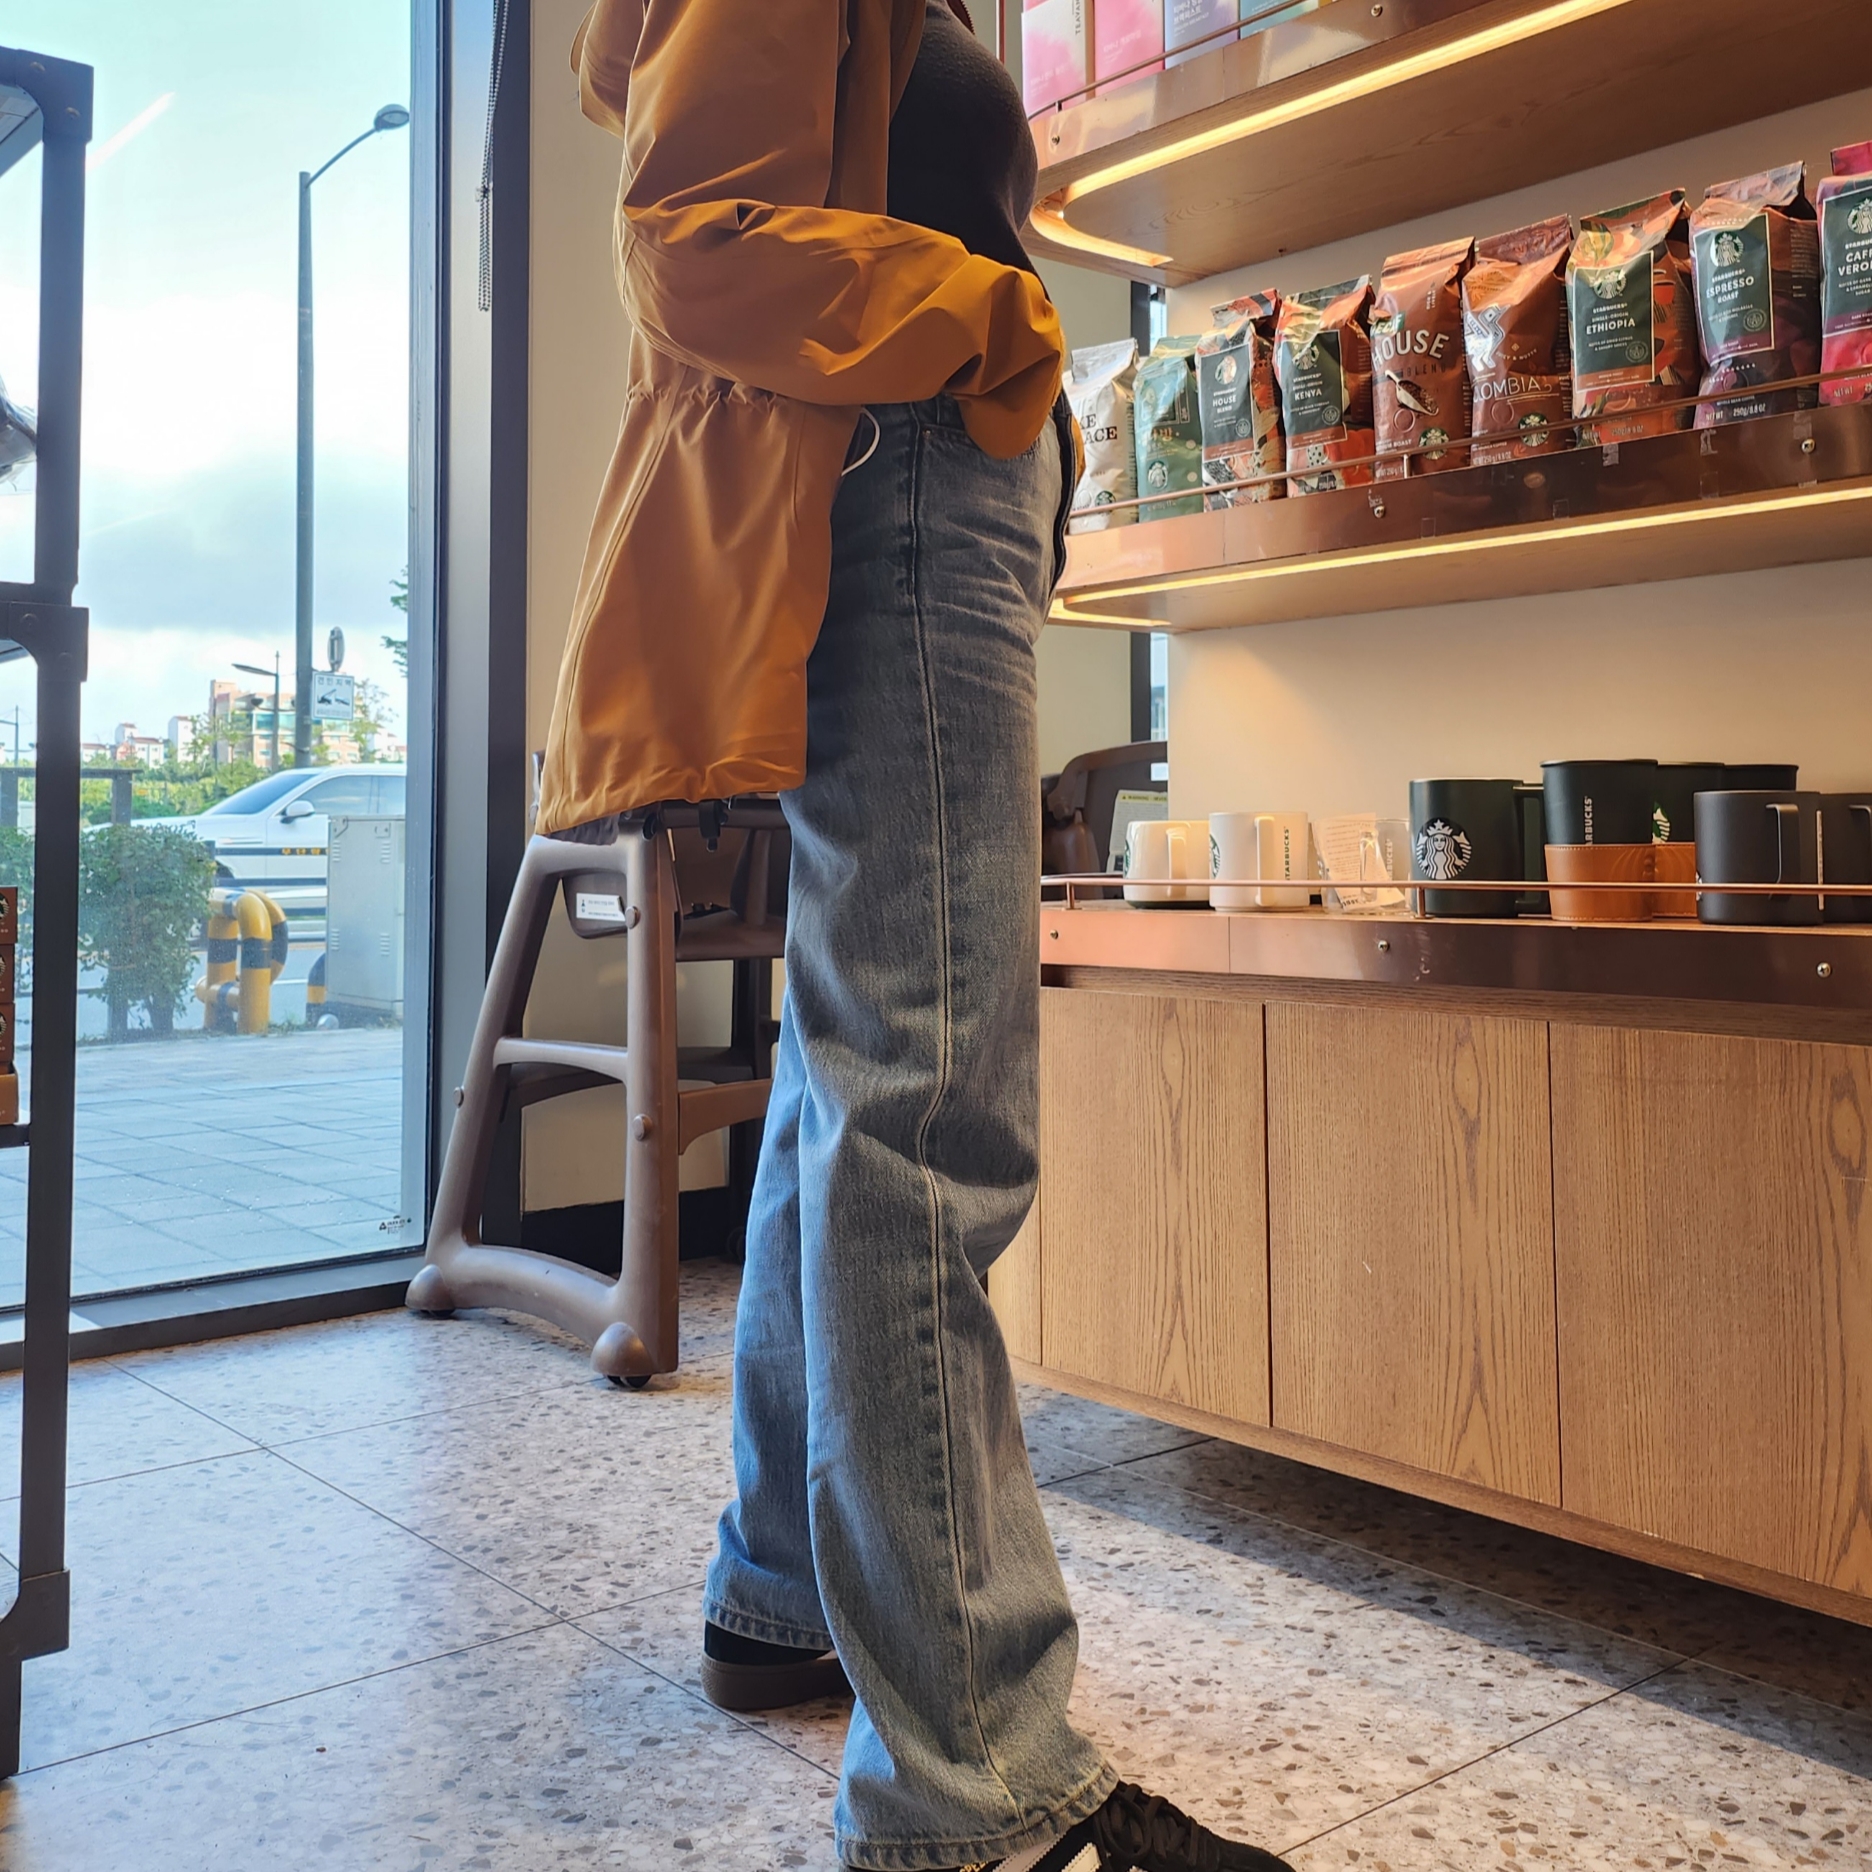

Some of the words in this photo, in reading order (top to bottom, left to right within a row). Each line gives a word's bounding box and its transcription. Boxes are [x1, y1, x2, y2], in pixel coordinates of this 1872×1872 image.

[1706, 275, 1755, 298] ESPRESSO
[1717, 290, 1739, 303] ROAST
[1586, 317, 1636, 335] ETHIOPIA
[1371, 329, 1450, 372] HOUSE
[1212, 394, 1237, 407] HOUSE
[1294, 388, 1322, 401] KENYA
[1084, 426, 1118, 445] ACE
[1584, 798, 1593, 845] RBUCKS
